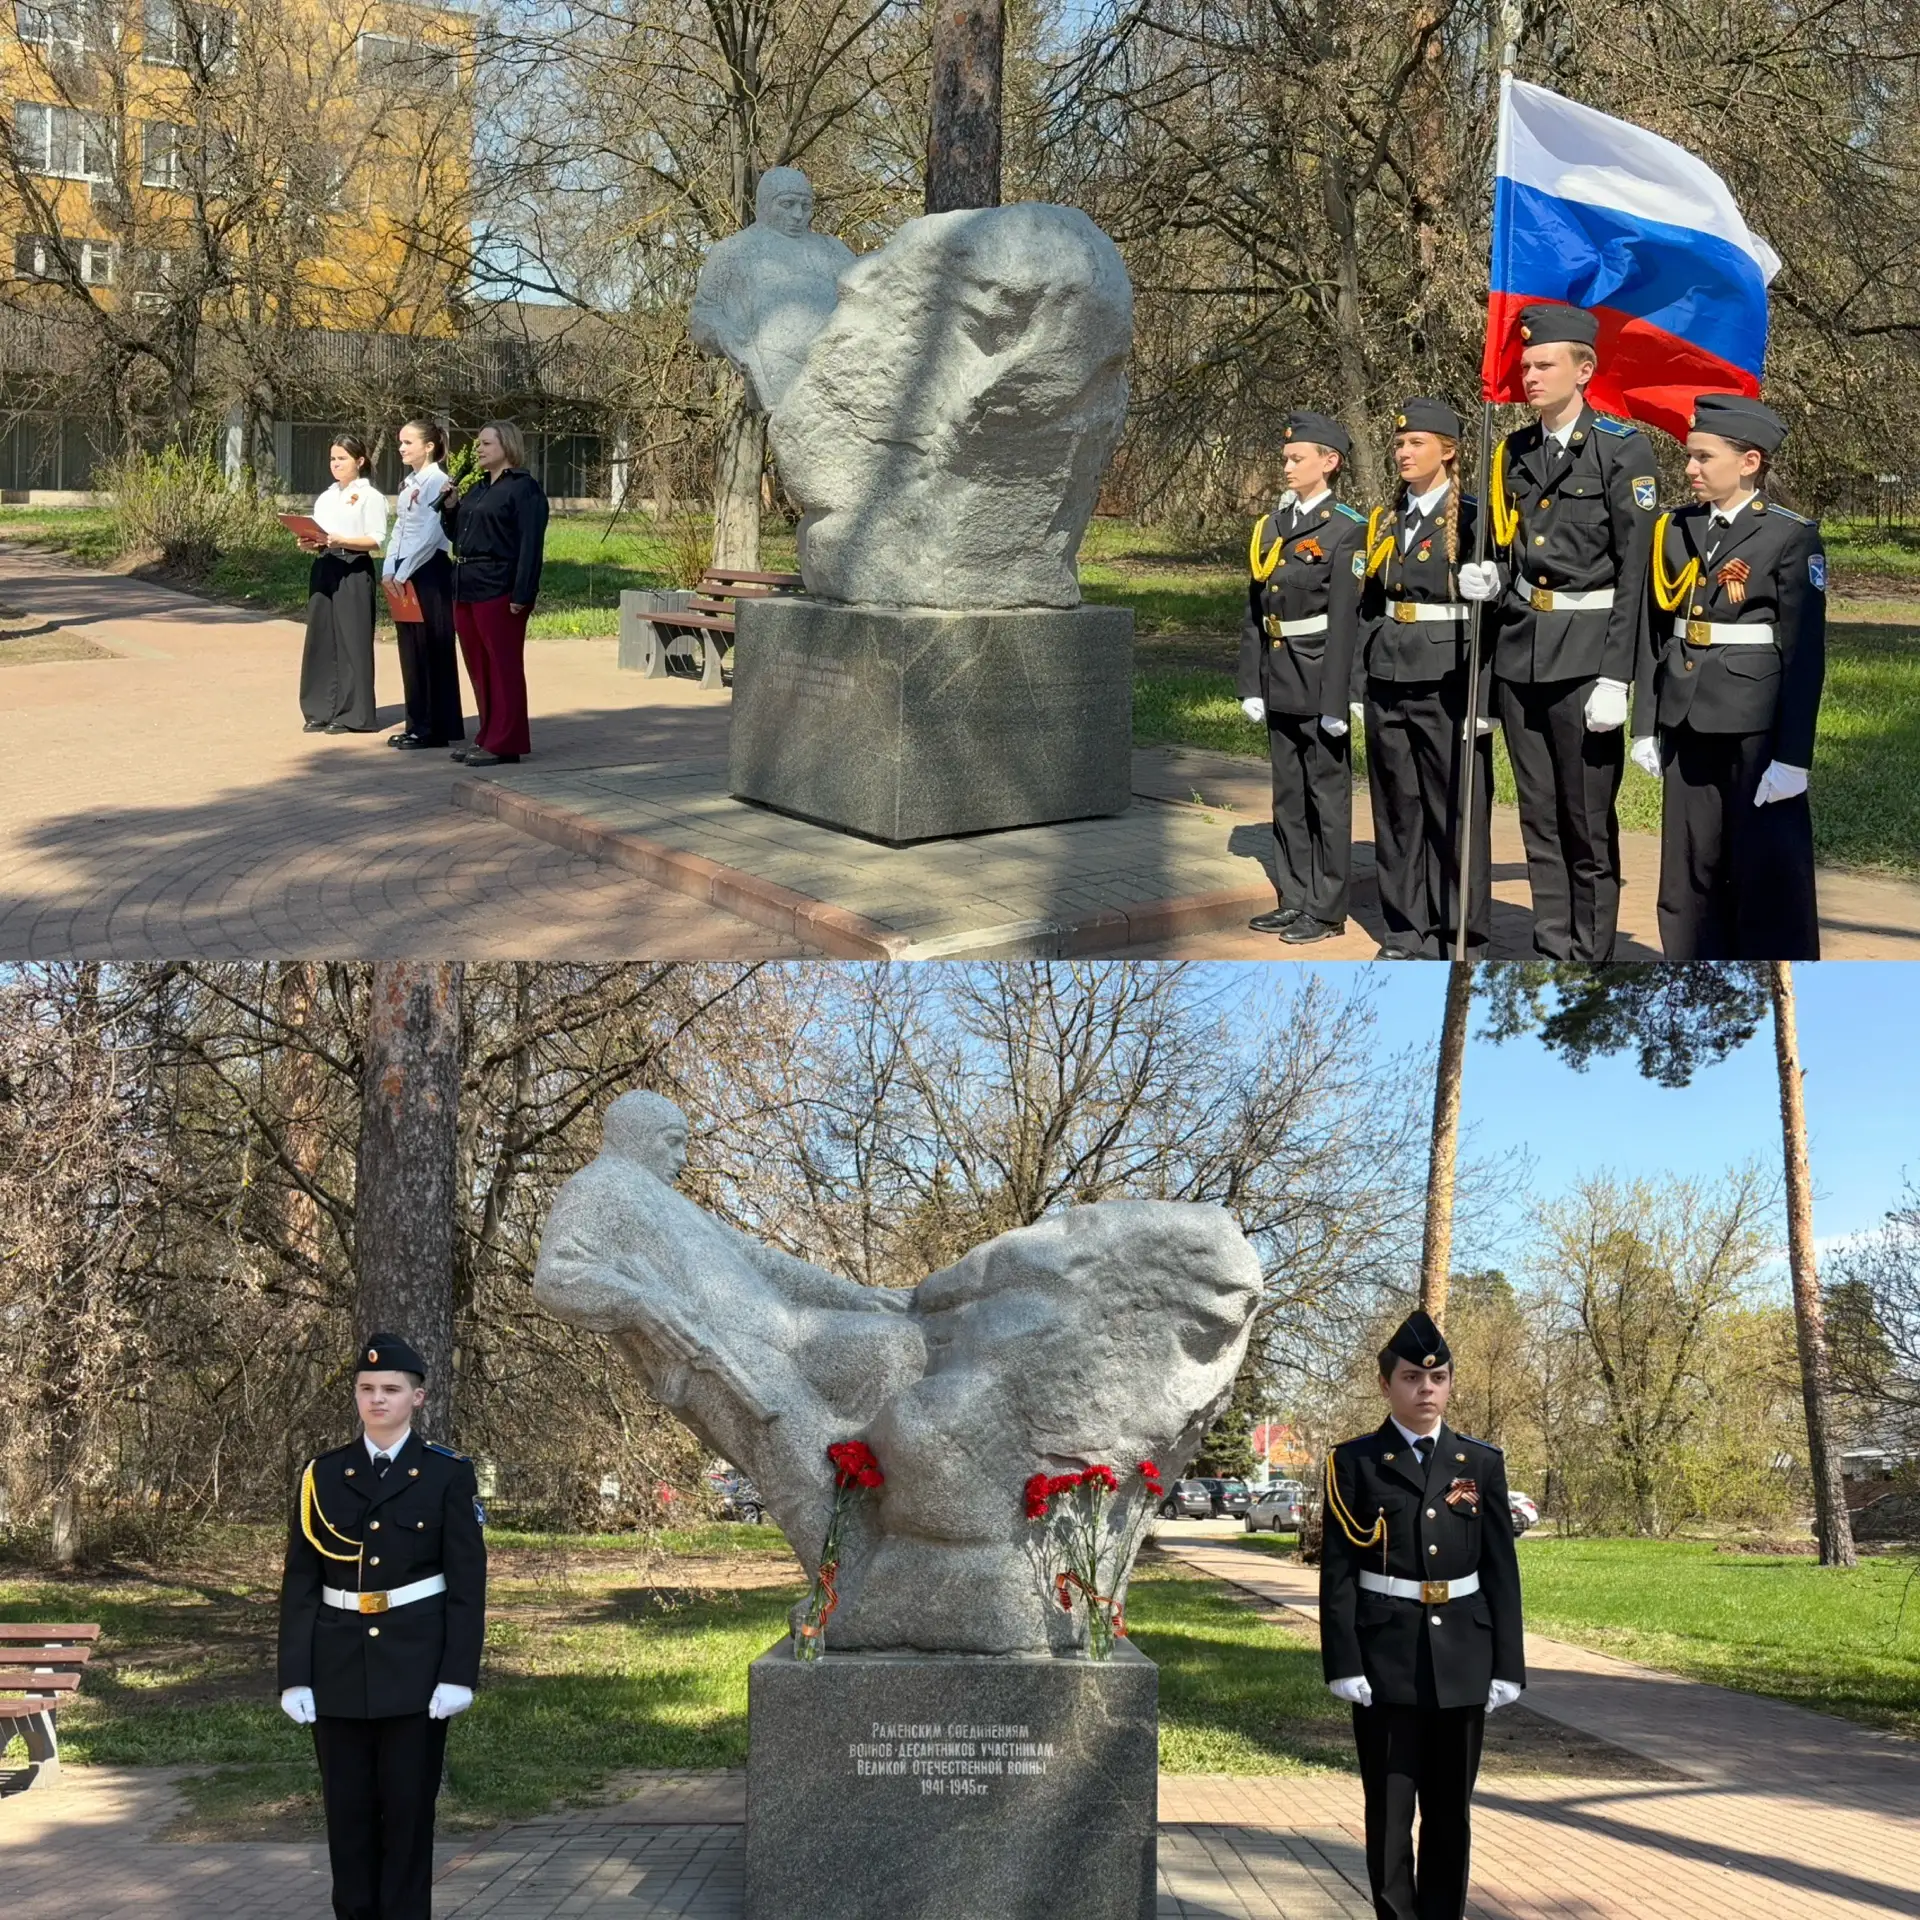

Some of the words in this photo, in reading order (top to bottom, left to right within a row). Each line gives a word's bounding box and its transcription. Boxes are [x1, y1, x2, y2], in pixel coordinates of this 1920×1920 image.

[980, 1742, 1055, 1758] УЧАСТНИКАМ
[857, 1759, 907, 1776] ВЕЛИКОЙ
[912, 1758, 1003, 1776] ОТЕЧЕСТВЕННОЙ
[1007, 1759, 1047, 1776] ВОЙНЫ
